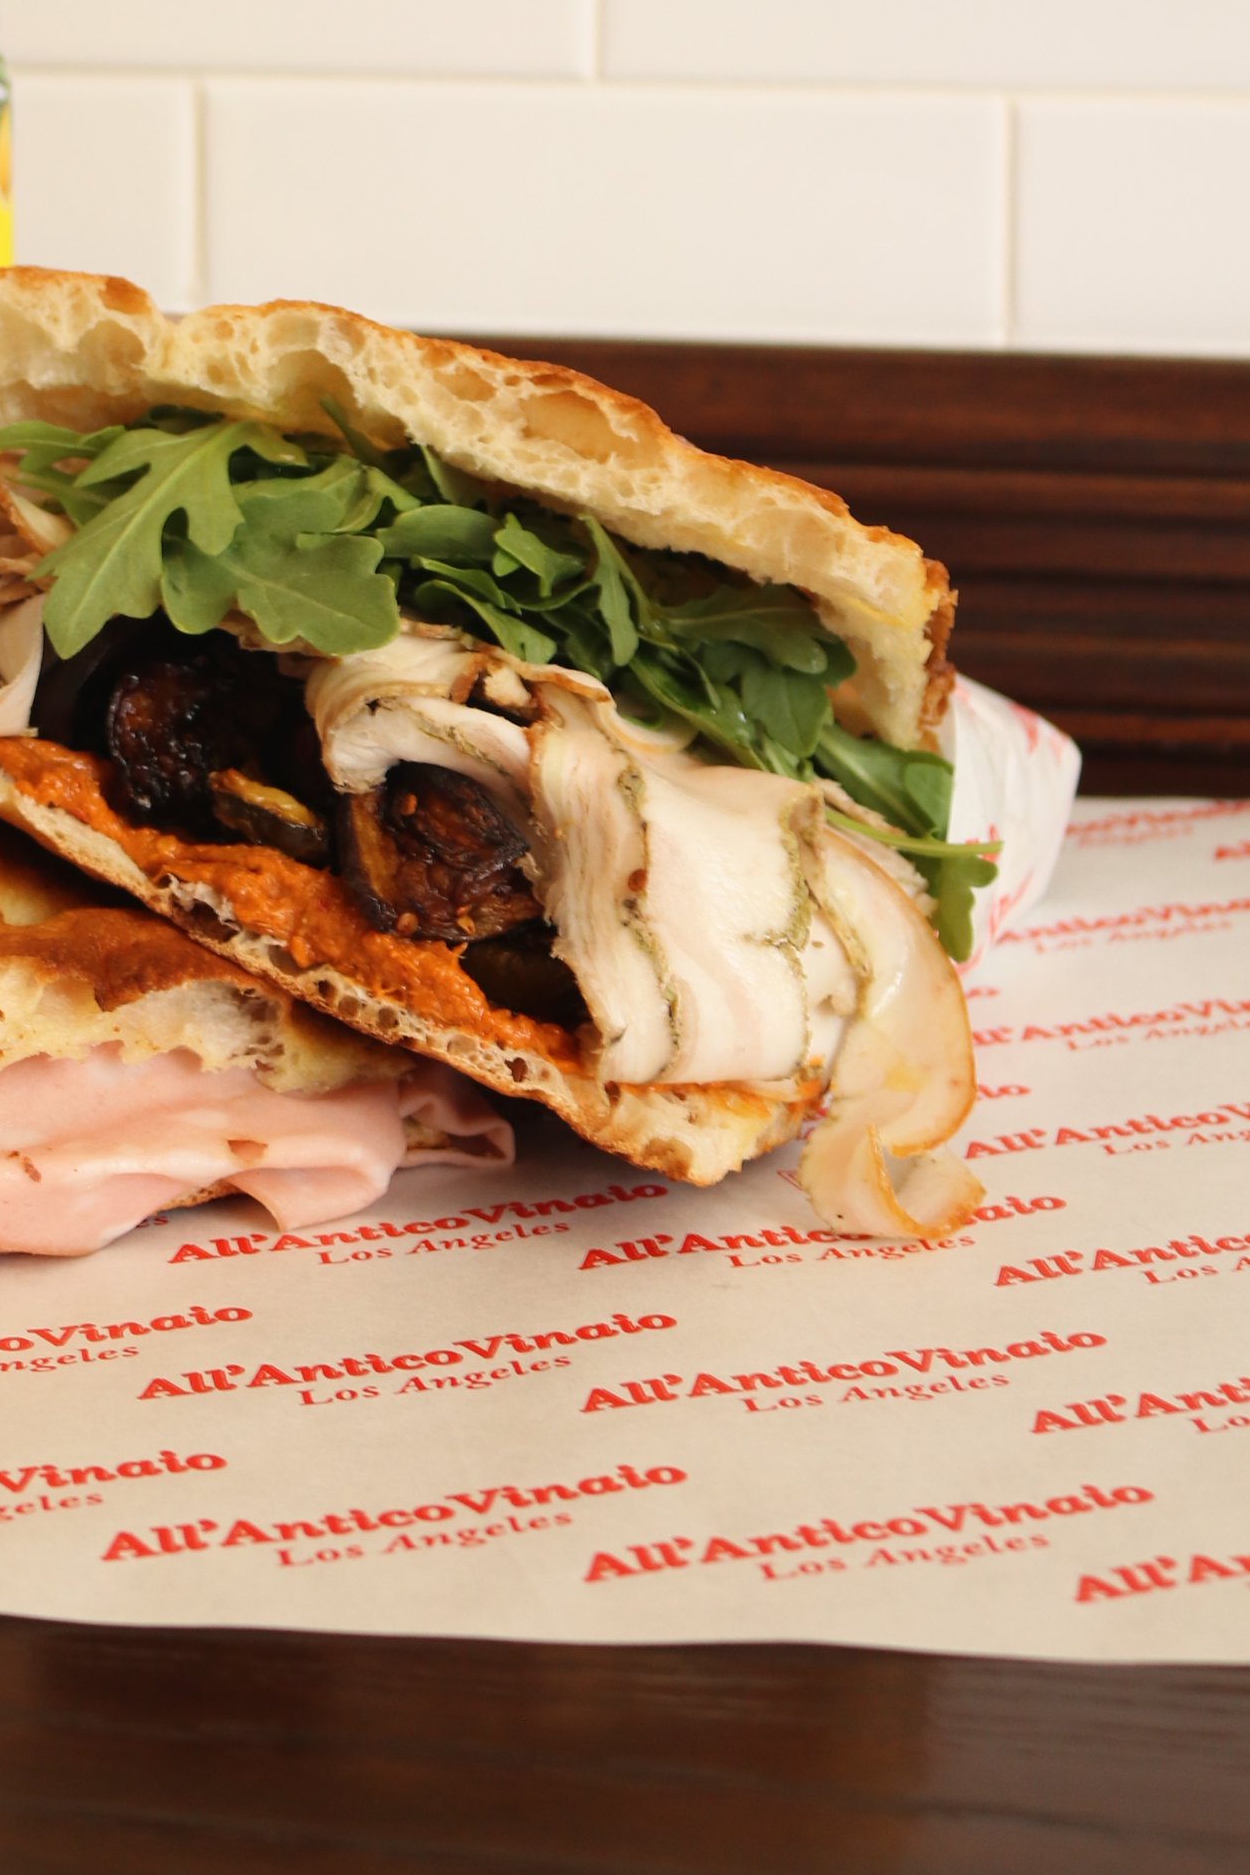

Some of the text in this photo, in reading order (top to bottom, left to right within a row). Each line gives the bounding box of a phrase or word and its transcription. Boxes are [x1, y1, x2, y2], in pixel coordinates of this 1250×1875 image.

[1102, 1140, 1170, 1157] Los
[316, 1222, 571, 1266] Los Angeles
[726, 1235, 976, 1269] Los Angeles
[1140, 1266, 1219, 1285] Los
[135, 1312, 679, 1401] All'AnticoVinaio
[297, 1356, 572, 1407] Los Angeles
[579, 1330, 1108, 1414] All'AnticoVinaio
[741, 1373, 1010, 1414] Los Angeles
[99, 1464, 688, 1563] All'AnticoVinaio
[581, 1483, 1156, 1584] All'AnticoVinaio
[275, 1513, 573, 1568] Los Angeles
[758, 1531, 1052, 1583] Los Angeles
